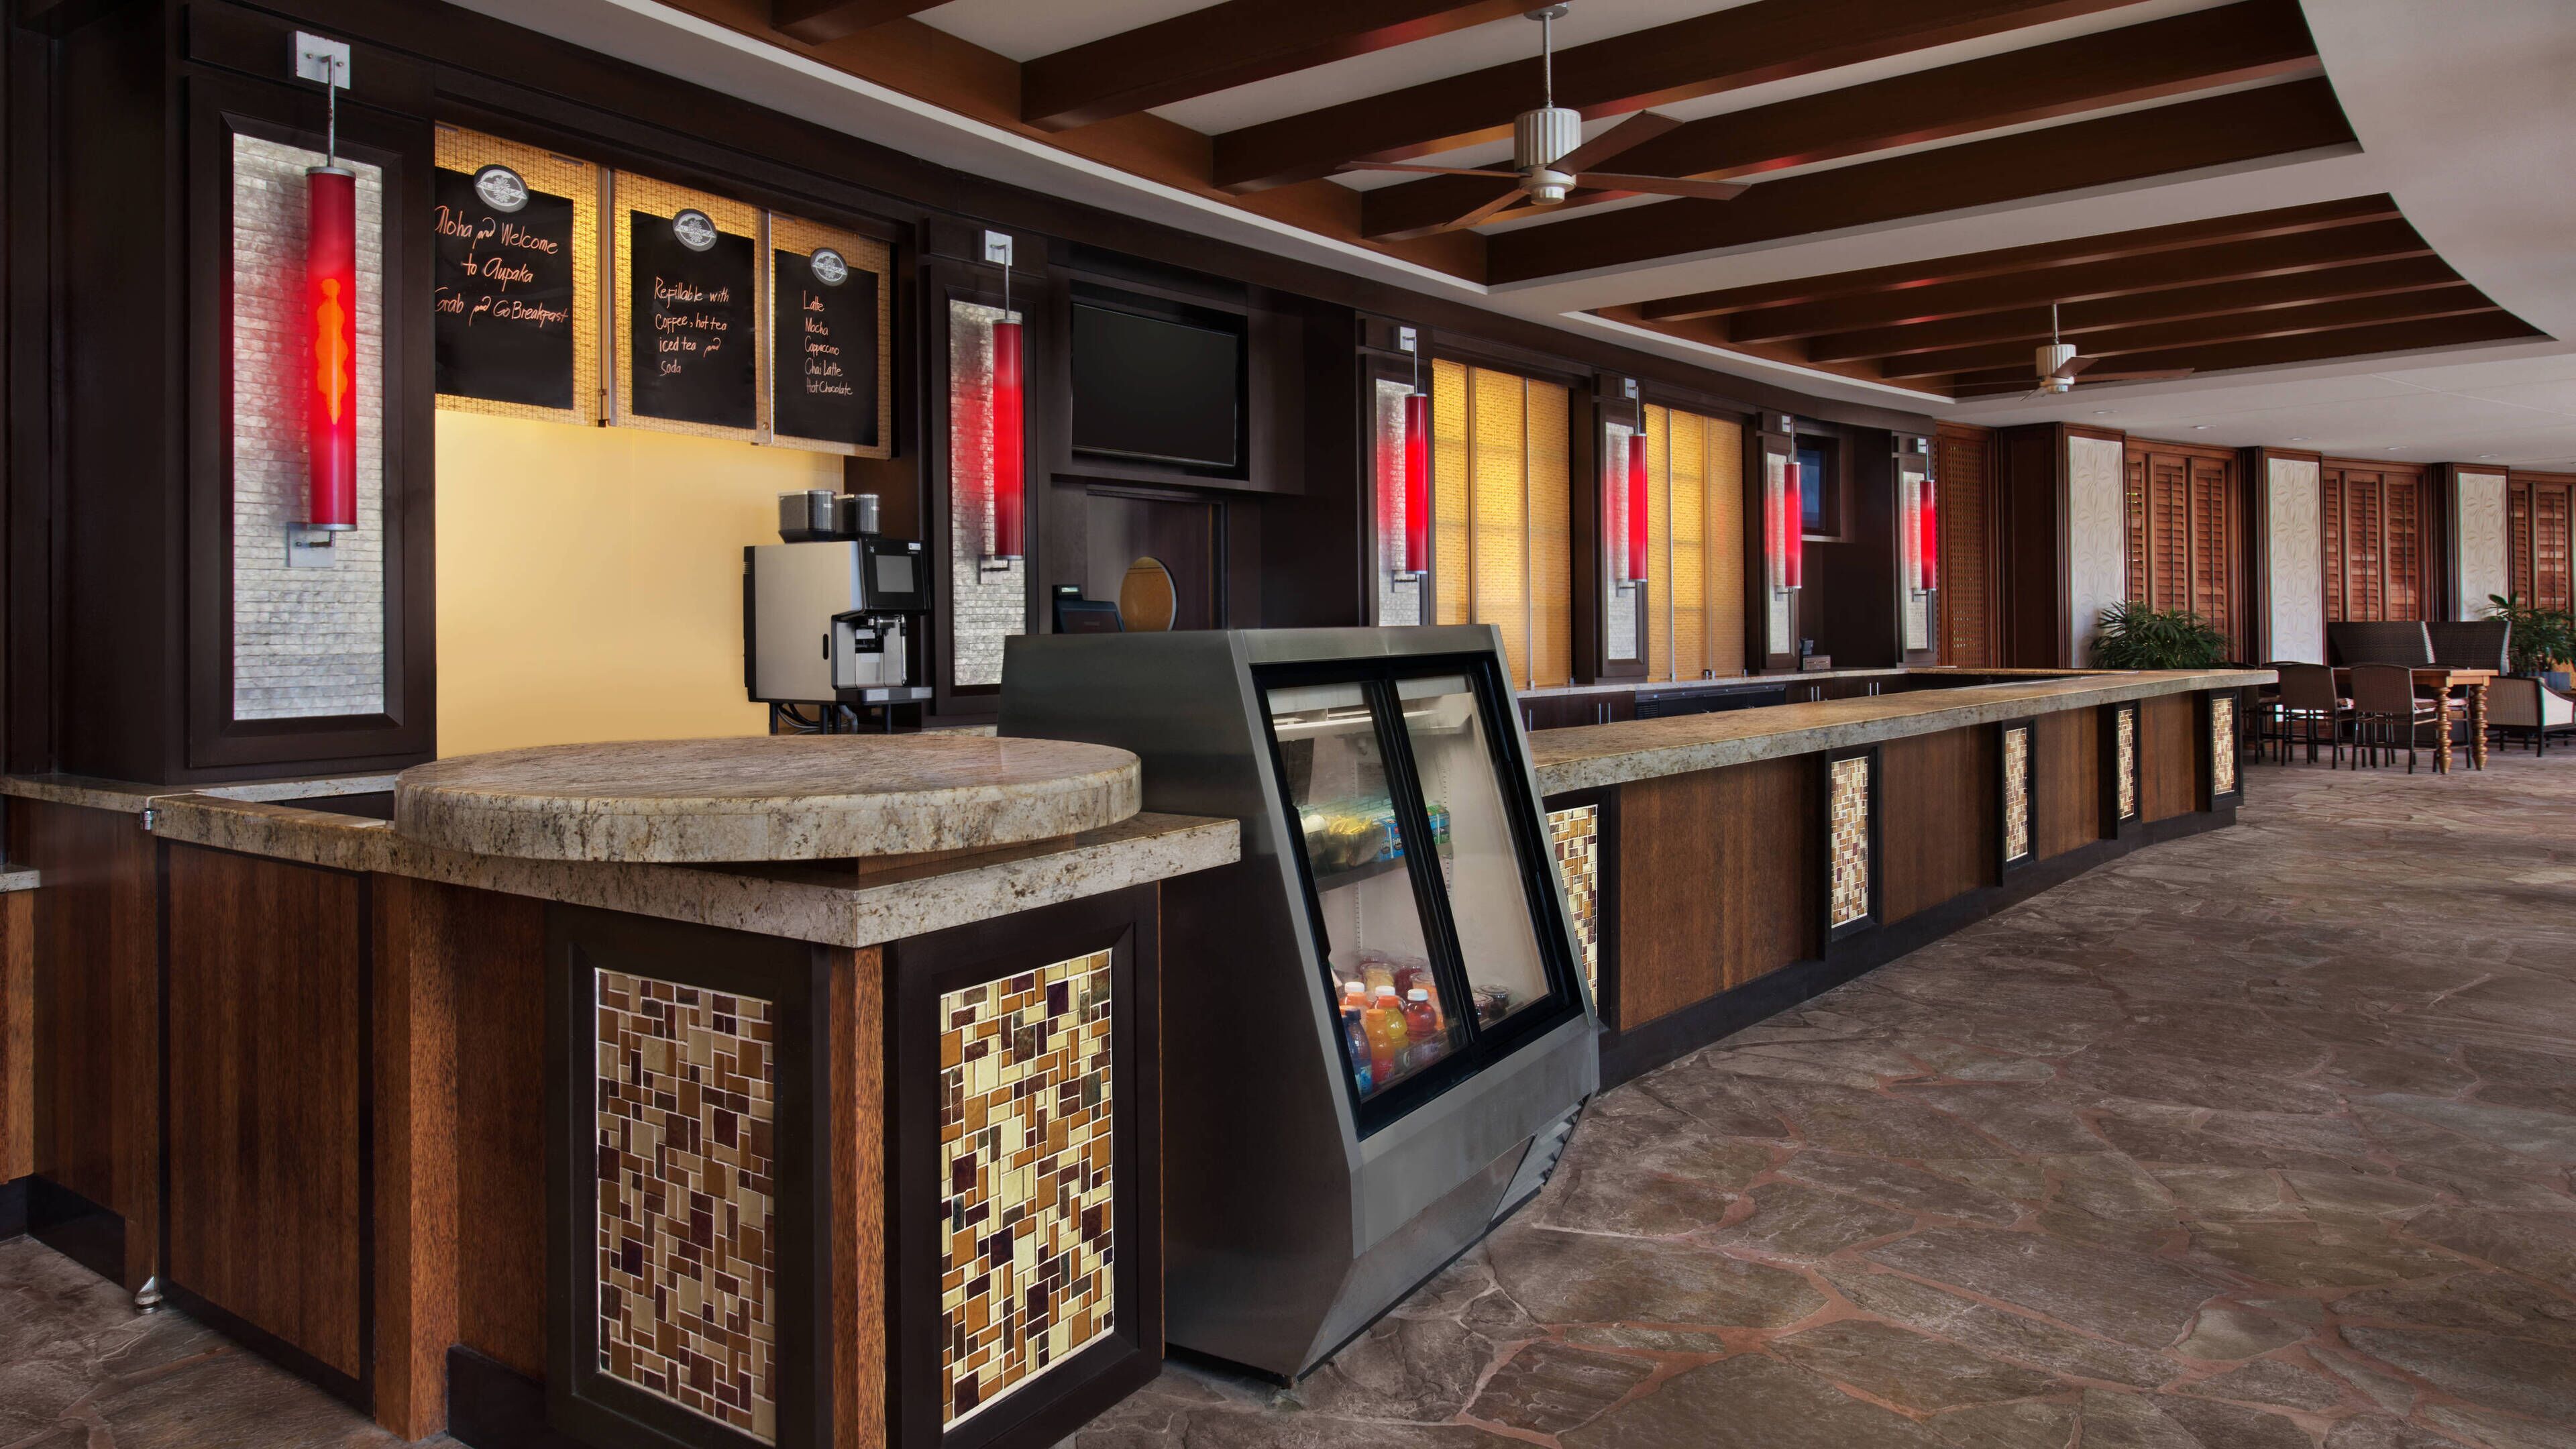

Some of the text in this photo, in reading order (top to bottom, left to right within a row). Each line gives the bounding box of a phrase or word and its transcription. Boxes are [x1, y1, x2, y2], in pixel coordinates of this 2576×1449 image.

[435, 205, 472, 237] Aloha
[501, 222, 558, 254] Welcome
[461, 253, 534, 291] to Aupaka
[654, 276, 729, 309] Refillable with
[803, 289, 824, 312] Latte
[493, 301, 511, 317] Go
[511, 301, 569, 328] Breakfast
[696, 312, 708, 330] hot
[710, 317, 727, 331] tea
[805, 317, 828, 335] Mocha
[659, 337, 679, 353] iced
[681, 337, 696, 351] tea
[805, 358, 843, 377] Chai Latte
[806, 377, 853, 396] Hot Chocolate
